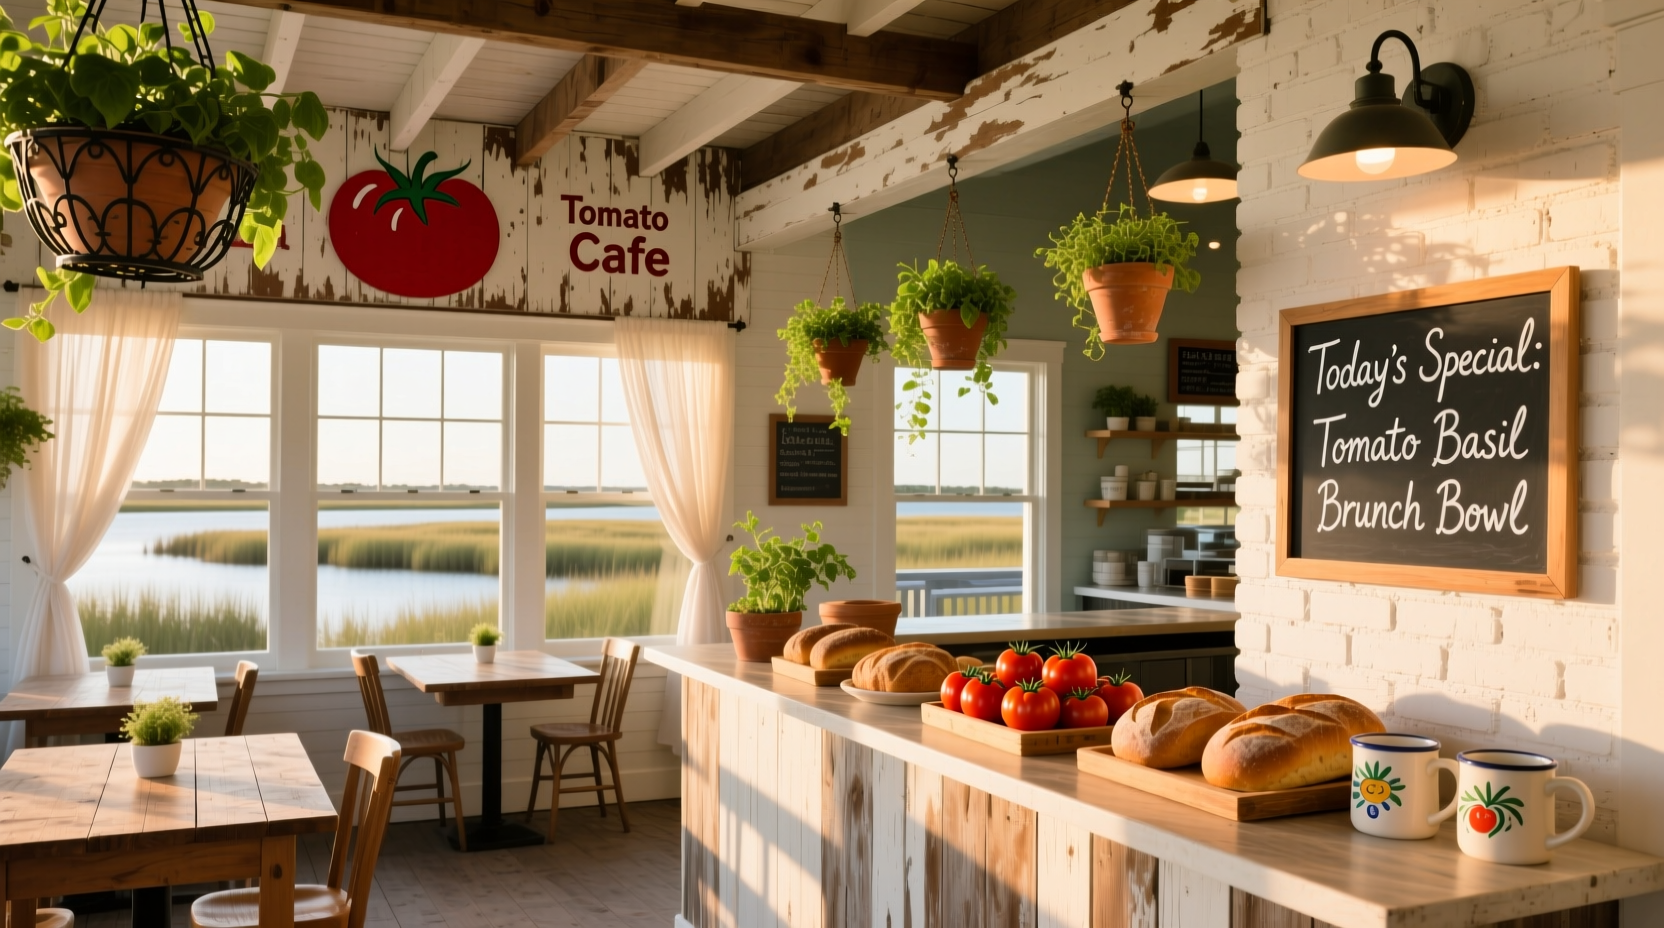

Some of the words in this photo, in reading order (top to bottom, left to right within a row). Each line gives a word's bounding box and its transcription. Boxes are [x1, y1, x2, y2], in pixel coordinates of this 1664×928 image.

[560, 194, 669, 231] Tomato
[569, 232, 670, 277] Cafe
[1308, 338, 1408, 408] Today's
[1419, 317, 1542, 403] Special:
[1313, 413, 1422, 468] Tomato
[1432, 404, 1529, 467] Basil
[1316, 478, 1426, 534] Brunch
[1435, 479, 1529, 535] Bowl
